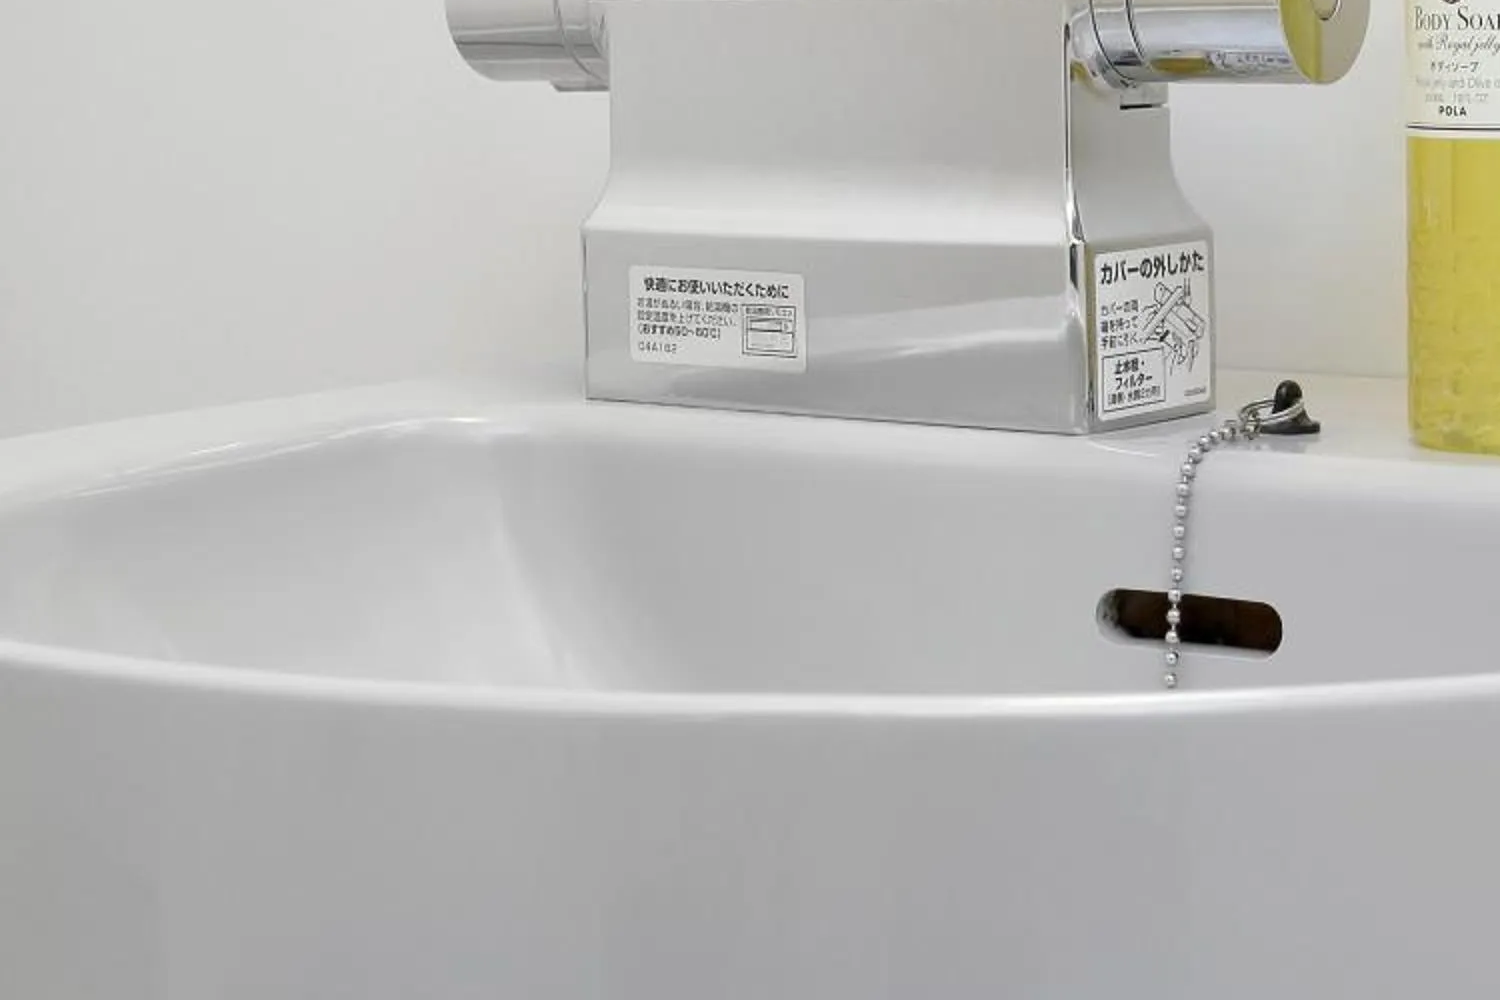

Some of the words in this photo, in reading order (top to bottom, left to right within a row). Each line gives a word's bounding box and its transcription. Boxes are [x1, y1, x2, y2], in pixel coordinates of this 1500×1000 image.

[1438, 105, 1467, 117] POLA
[1100, 250, 1205, 285] カバーの外しかた
[644, 277, 789, 299] 快適にお使いいただくために
